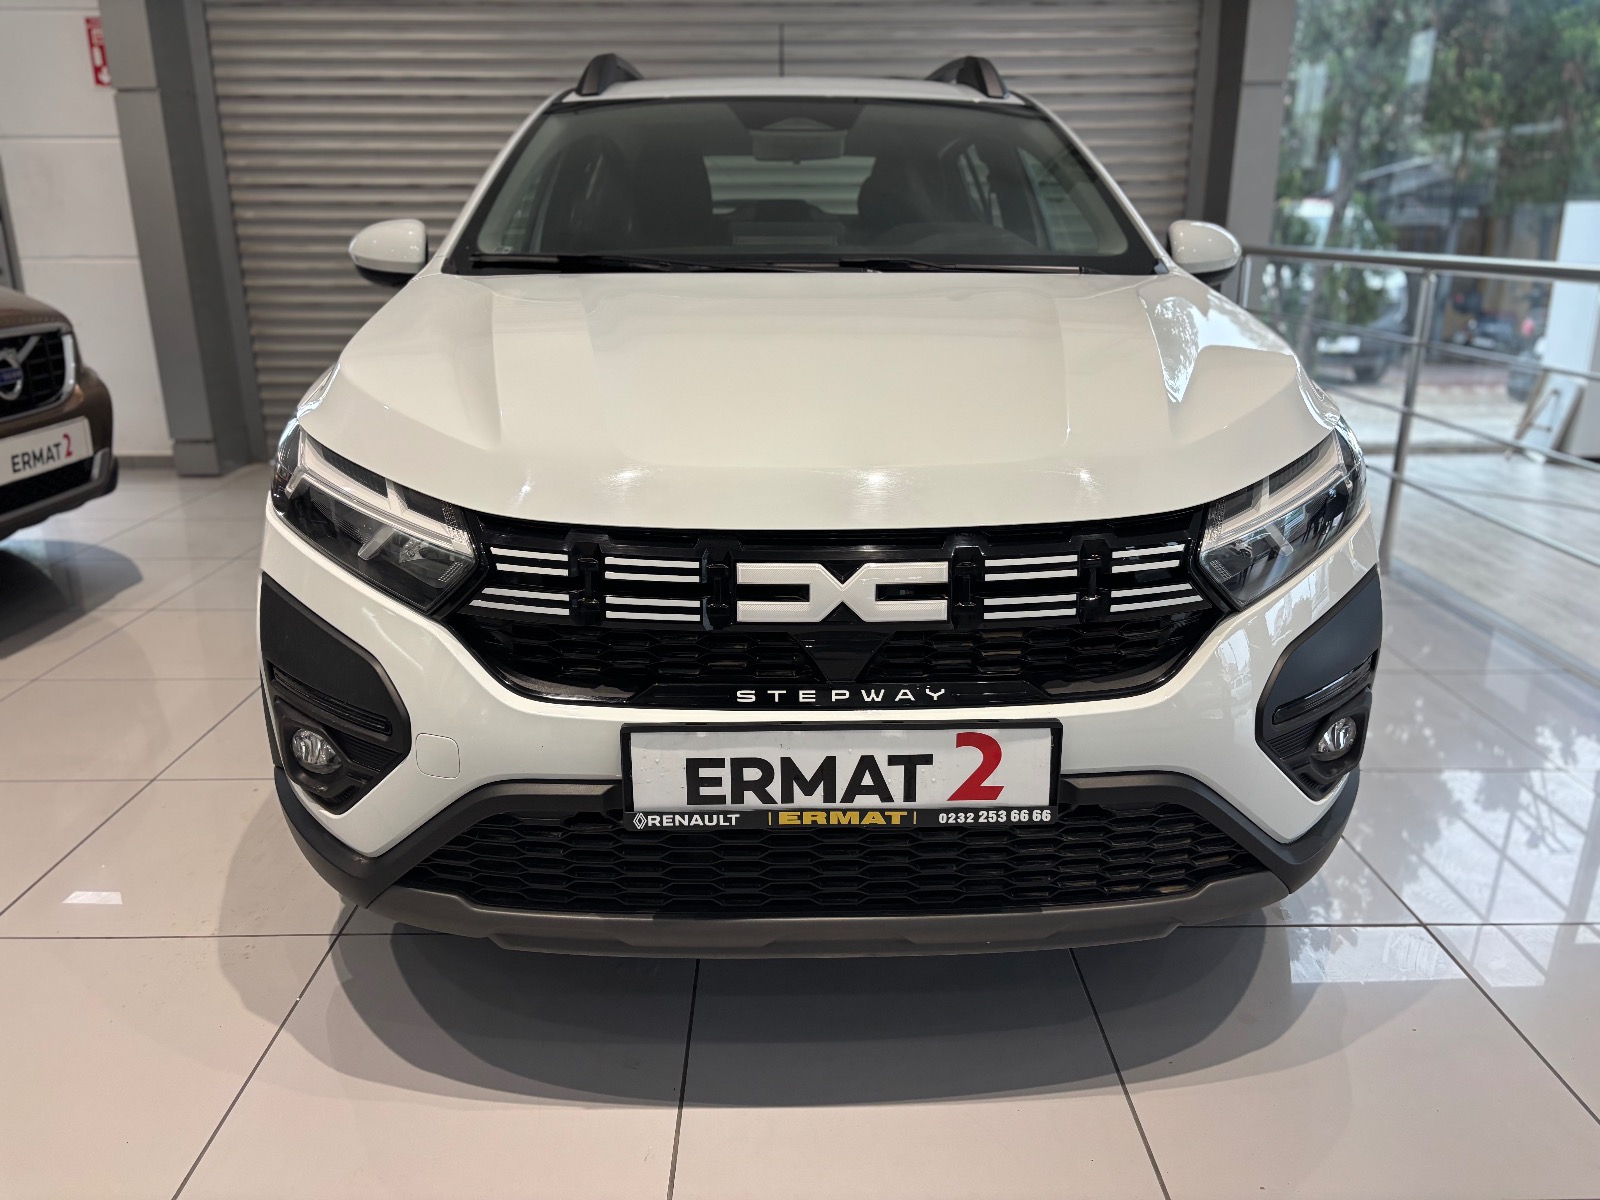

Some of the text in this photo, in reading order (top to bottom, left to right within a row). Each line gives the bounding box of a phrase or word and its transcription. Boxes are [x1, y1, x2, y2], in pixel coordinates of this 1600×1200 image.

[11, 432, 73, 473] ERMAT 2
[736, 688, 946, 703] STEPWAY
[685, 732, 1005, 805] ERMAT 2
[647, 814, 740, 827] RENAULT
[778, 811, 908, 825] ERMAT
[938, 809, 1052, 824] 0232 253 66 66
